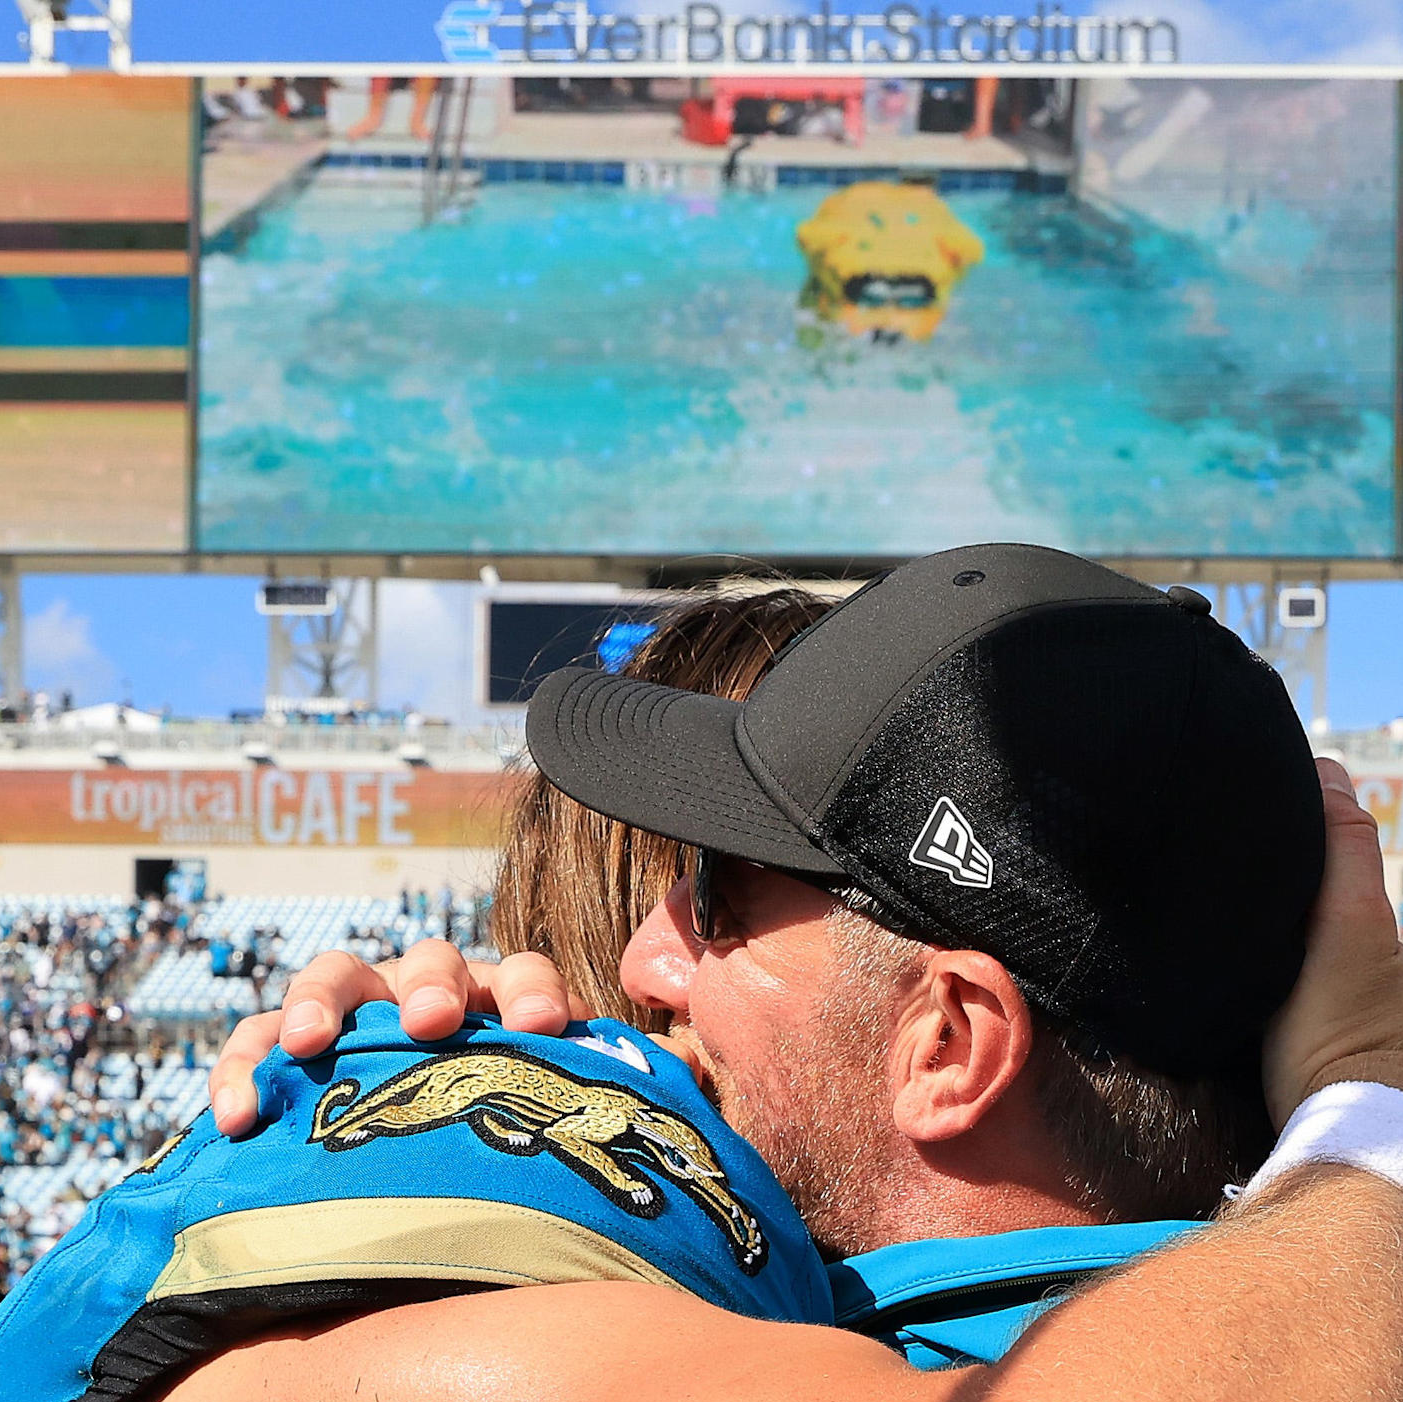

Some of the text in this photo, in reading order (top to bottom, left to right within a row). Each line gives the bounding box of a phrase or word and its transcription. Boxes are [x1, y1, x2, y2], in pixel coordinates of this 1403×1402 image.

[522, 0, 1181, 63] EverBank Stadium
[69, 767, 418, 845] tropical CAFE
